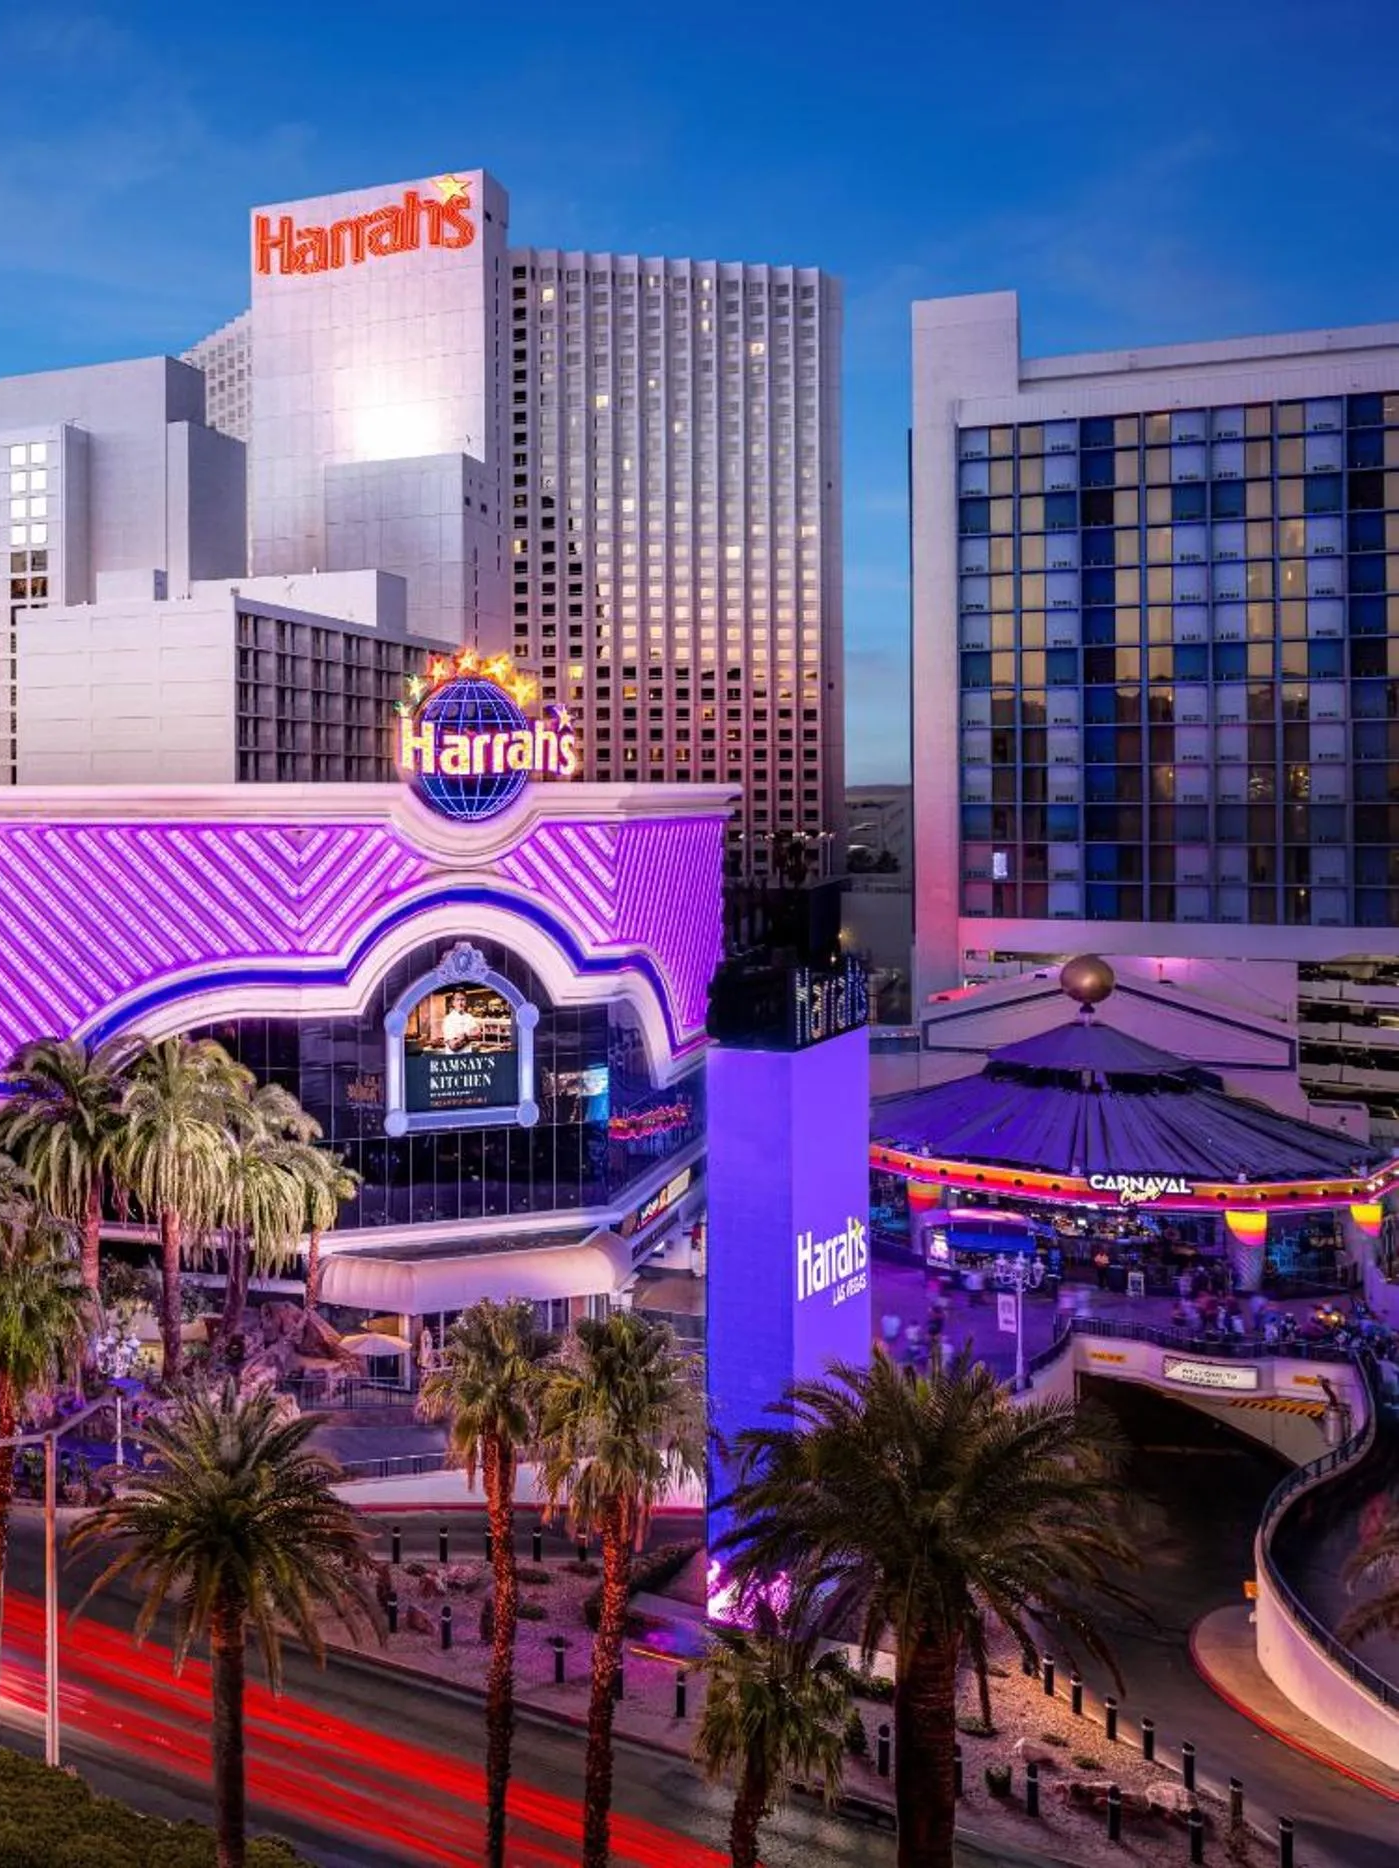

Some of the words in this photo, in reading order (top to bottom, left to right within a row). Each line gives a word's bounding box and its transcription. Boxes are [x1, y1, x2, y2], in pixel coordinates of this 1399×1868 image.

[429, 1056, 496, 1074] RAMSAY'S
[429, 1073, 492, 1091] KITCHEN
[1090, 1174, 1192, 1194] CARNAVAL
